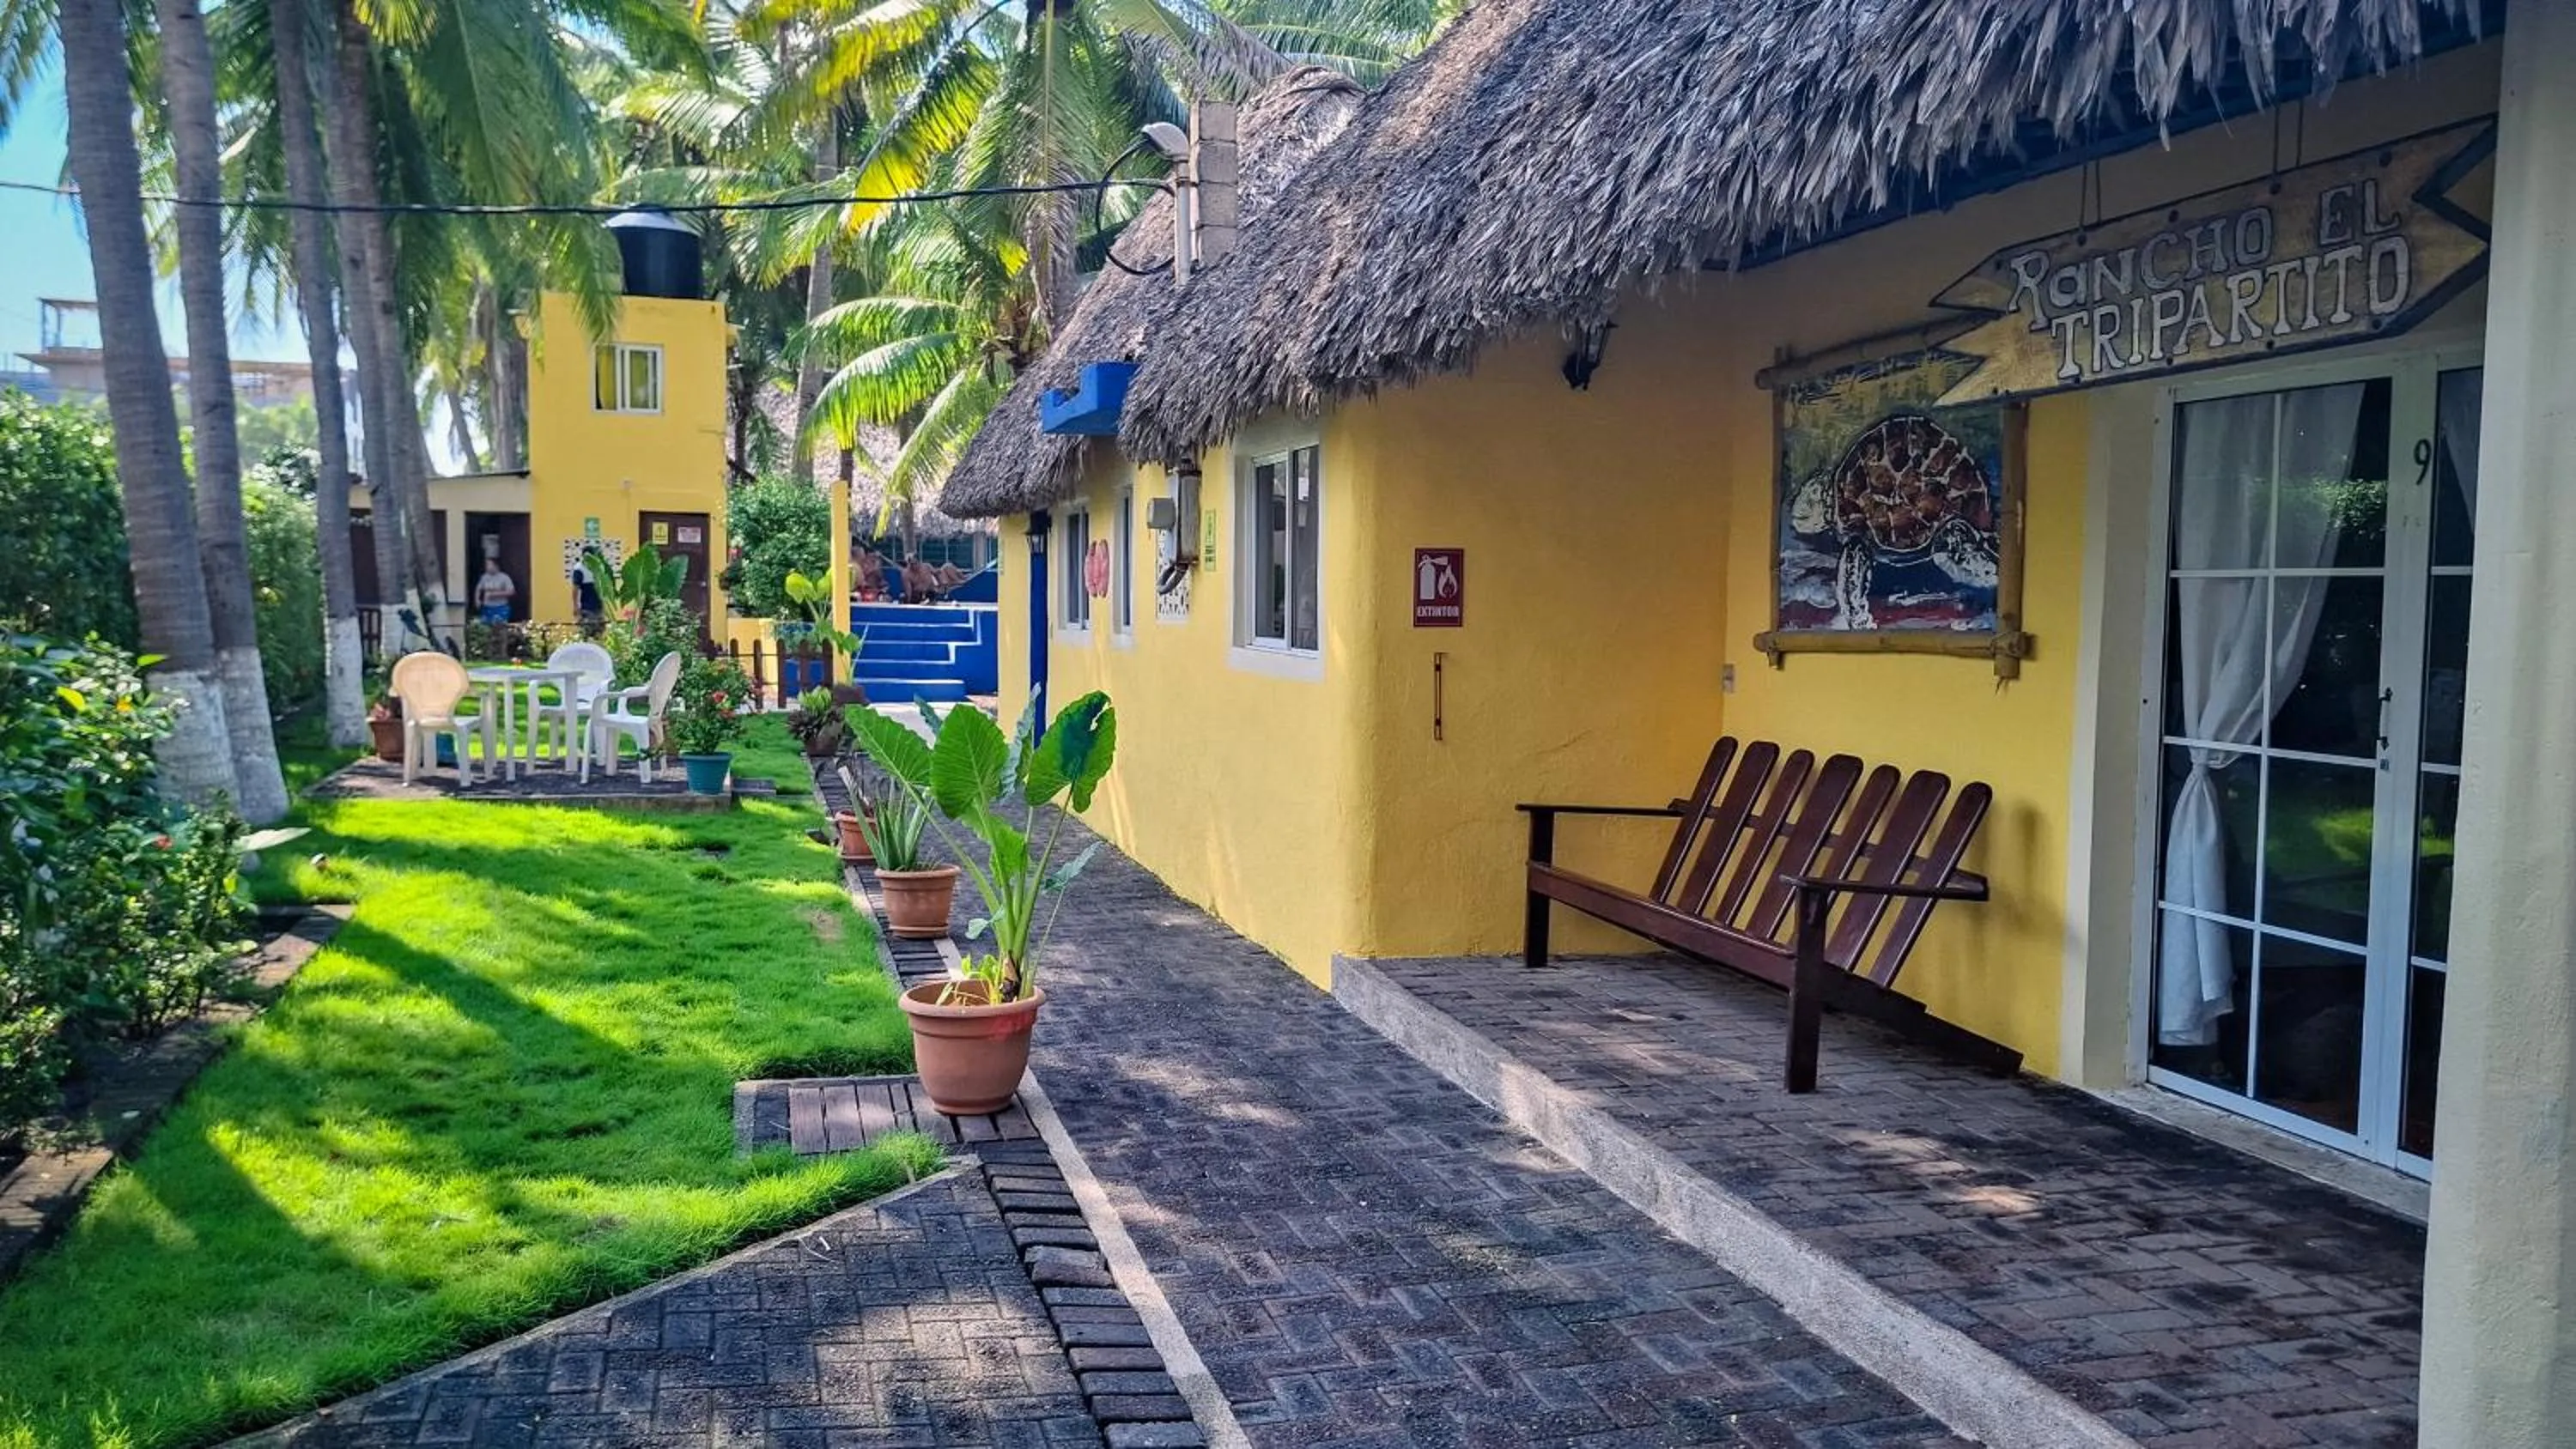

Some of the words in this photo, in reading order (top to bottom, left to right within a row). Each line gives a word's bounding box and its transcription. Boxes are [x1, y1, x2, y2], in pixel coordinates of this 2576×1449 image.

[2320, 179, 2402, 246] EL
[2050, 235, 2410, 379] TRIPARTITO
[2414, 439, 2432, 486] 9
[1417, 605, 1460, 617] EXTINTOR
